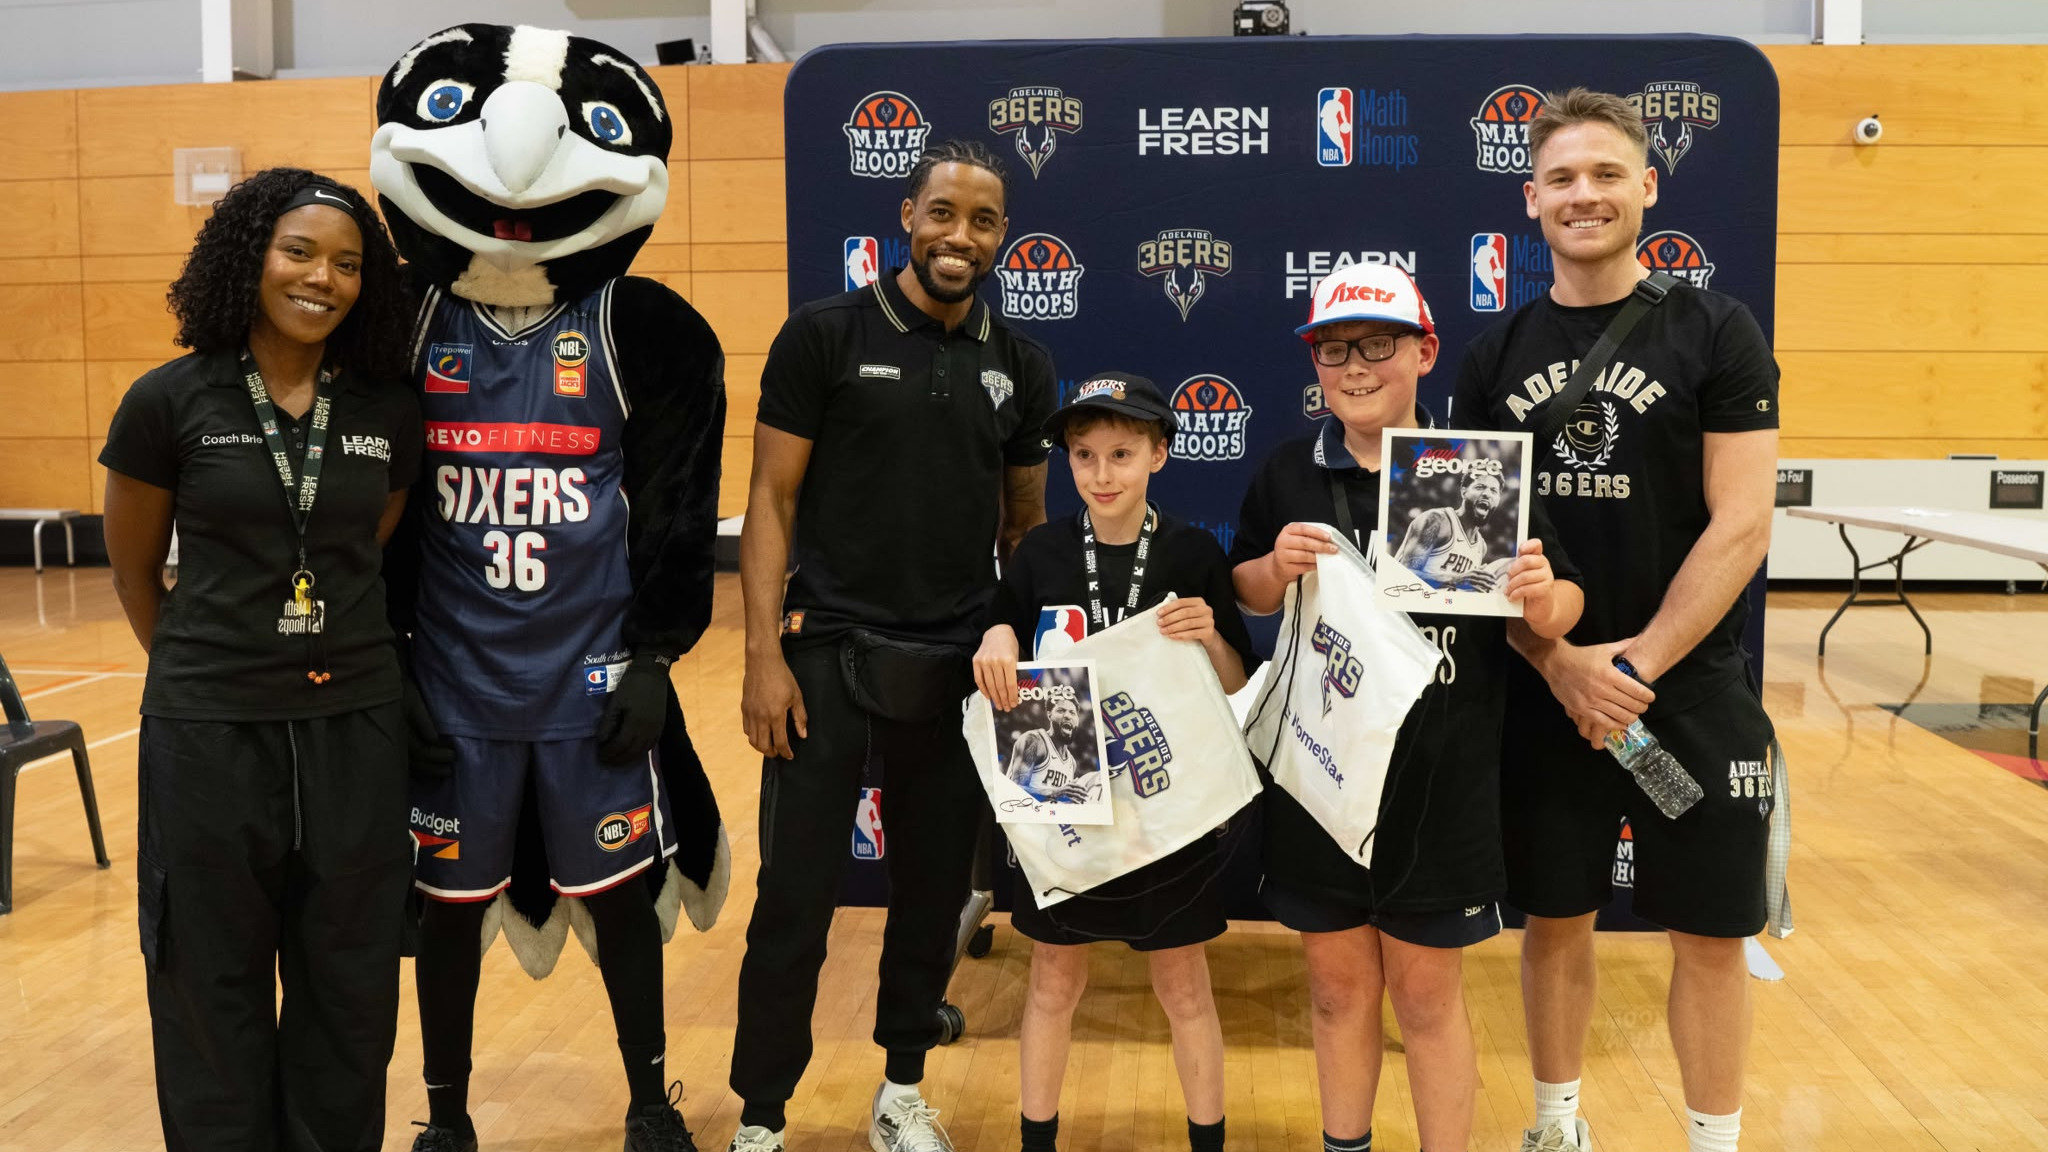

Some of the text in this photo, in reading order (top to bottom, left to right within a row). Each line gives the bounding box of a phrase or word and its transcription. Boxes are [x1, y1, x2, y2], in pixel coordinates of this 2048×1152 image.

[1012, 88, 1060, 97] ADELAIDE
[1648, 83, 1697, 92] ADELAIDE
[991, 96, 1080, 126] 36ERS
[1138, 107, 1269, 131] LEARN
[1359, 88, 1407, 127] Math
[849, 127, 926, 149] MATH
[1138, 131, 1269, 156] FRESH
[1476, 122, 1530, 144] MAT
[1322, 148, 1340, 162] NBA
[1359, 129, 1419, 170] Hoops
[1482, 144, 1533, 168] HOO
[1160, 231, 1209, 240] ADELAIDE
[883, 238, 911, 272] Ma
[1140, 239, 1230, 269] 36ERS
[1513, 234, 1553, 272] Mat
[1000, 268, 1079, 291] MATH
[1006, 292, 1077, 314] HOOPS
[1475, 293, 1493, 307] NBA
[558, 340, 581, 357] NBL
[861, 366, 899, 375] CHAMPION
[983, 373, 1013, 391] 36ERS
[245, 374, 262, 405] LEARN
[252, 371, 269, 403] FRESH
[1506, 359, 1668, 423] ADEAIDE
[312, 396, 324, 429] FRESH
[319, 398, 332, 430] LEARN
[1173, 411, 1247, 432] MATH
[201, 433, 263, 446] Coach Brie
[427, 428, 595, 450] REVO FITNESS
[1173, 432, 1241, 456] HOOPS
[343, 445, 392, 463] FRESH
[278, 451, 294, 486] FRESH
[1415, 455, 1503, 480] george
[1787, 470, 1804, 483] Foul
[1997, 471, 2039, 485] Possession
[299, 475, 311, 511] FRESH
[305, 476, 318, 511] LEARN
[437, 464, 592, 526] SIXERS
[1537, 471, 1631, 499] 36ERS
[482, 530, 548, 592] 36
[1322, 625, 1350, 651] LAIDE
[583, 652, 607, 665] South
[1102, 692, 1170, 796] 36ERS
[1140, 709, 1171, 762] ADELAIDE
[410, 806, 461, 835] Budget
[603, 822, 625, 842] NBL
[856, 842, 873, 855] NBA
